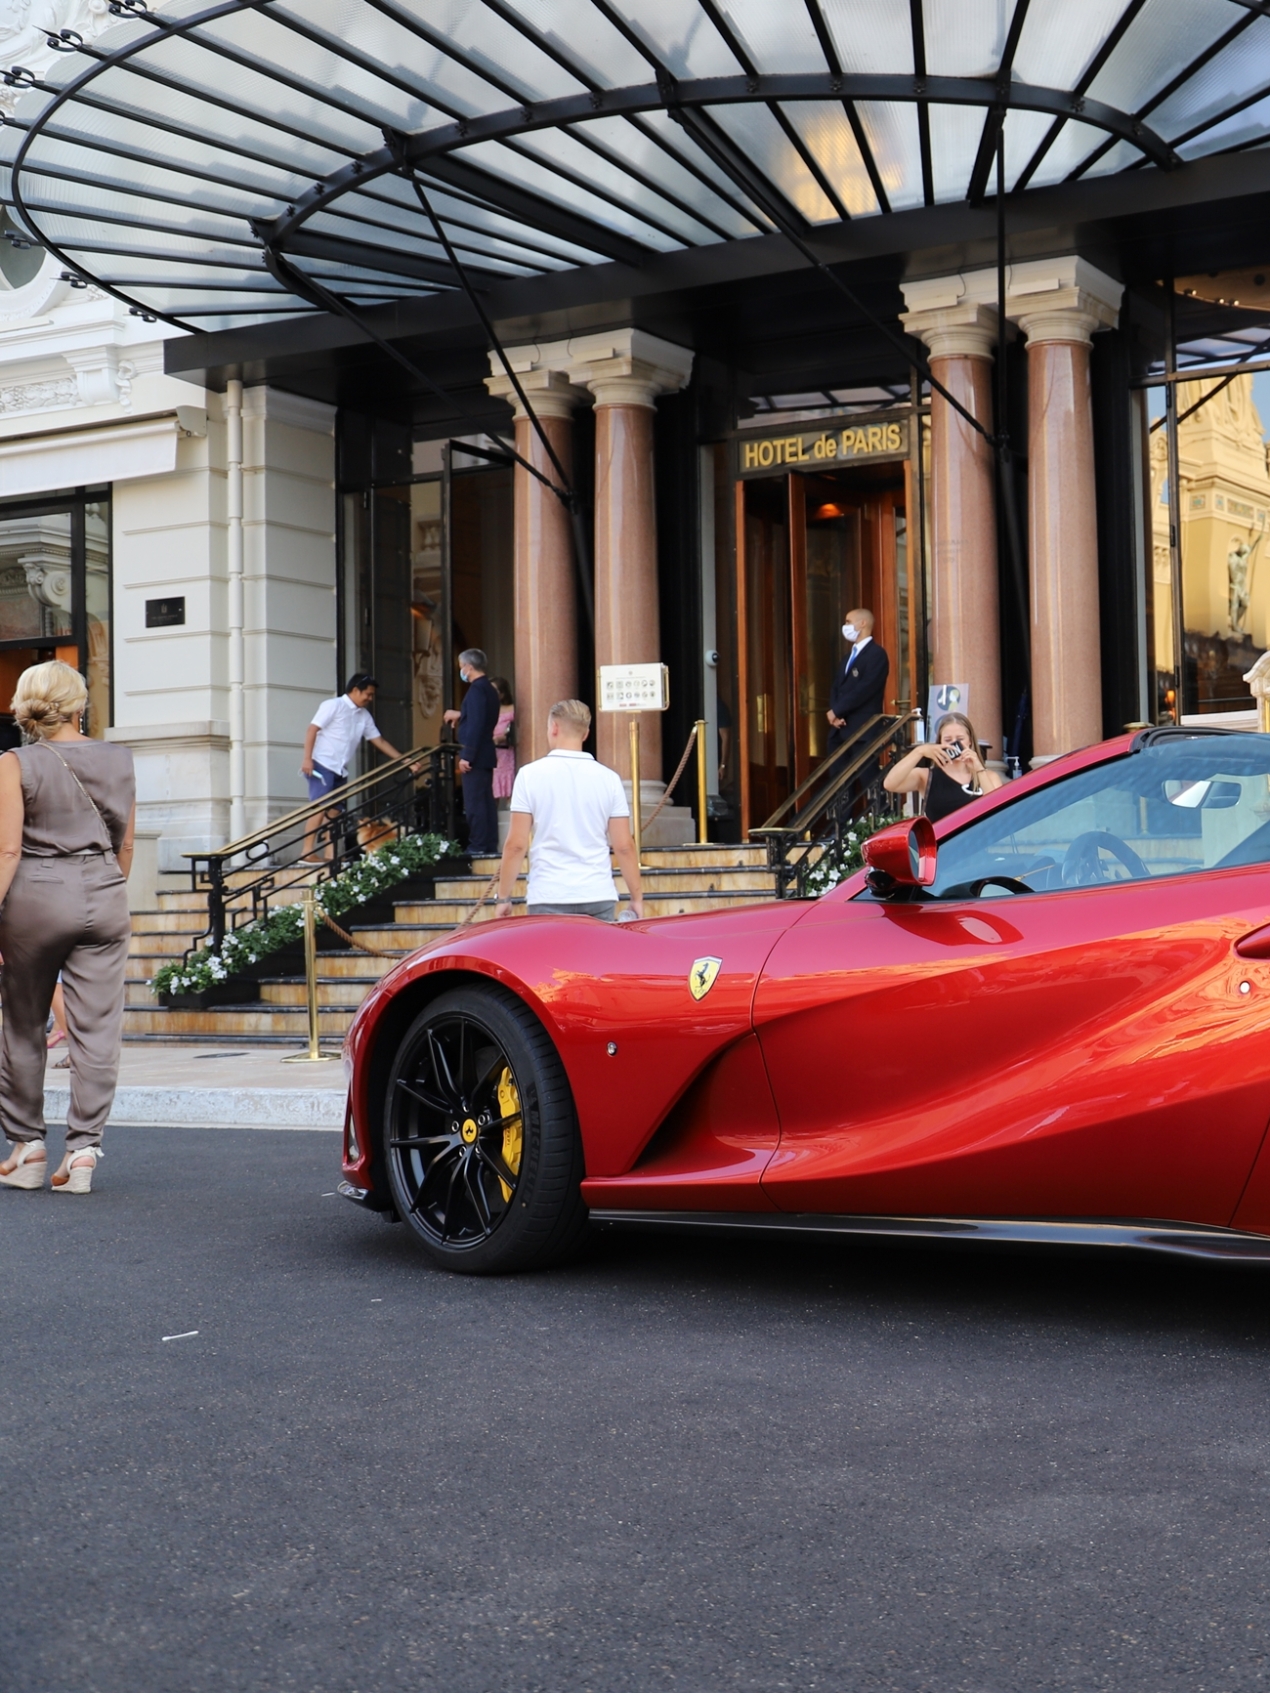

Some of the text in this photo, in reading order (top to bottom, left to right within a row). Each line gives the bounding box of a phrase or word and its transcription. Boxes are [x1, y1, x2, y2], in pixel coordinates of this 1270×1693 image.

[744, 424, 902, 468] HOTEL de PARIS
